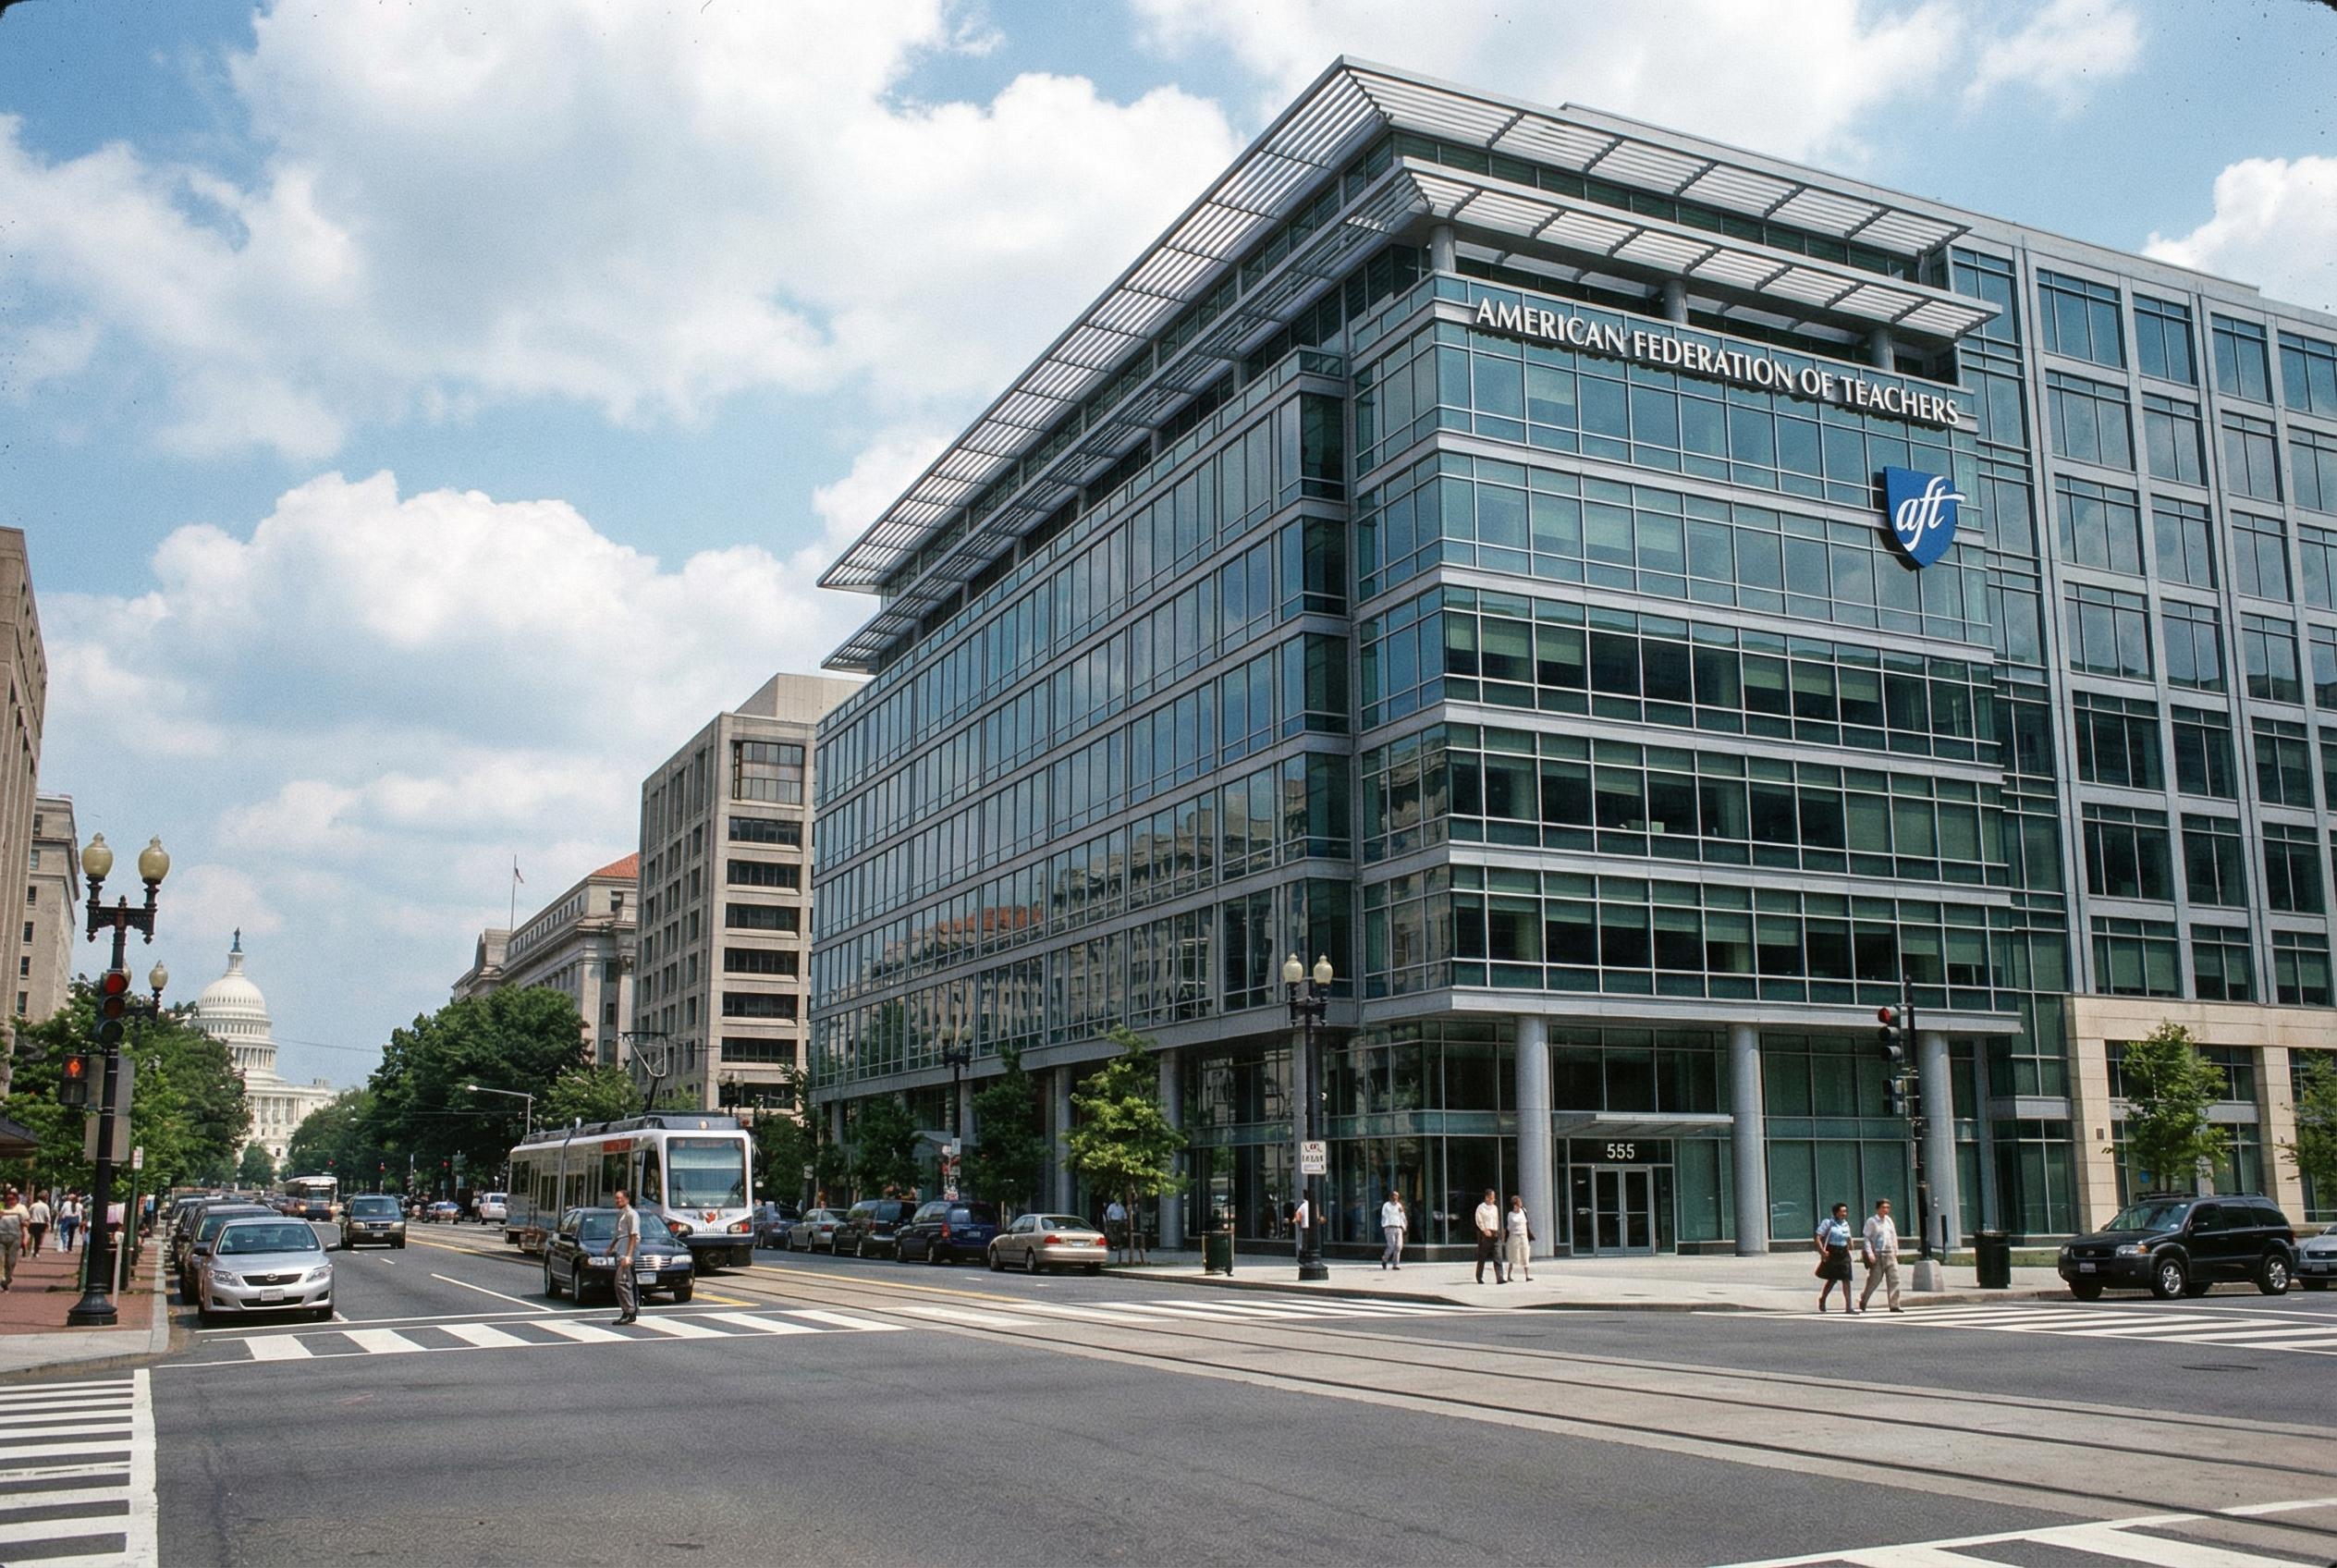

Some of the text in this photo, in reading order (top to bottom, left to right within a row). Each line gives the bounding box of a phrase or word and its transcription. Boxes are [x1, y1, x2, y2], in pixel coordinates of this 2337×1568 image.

[1476, 297, 1959, 425] AMERICAN FEDERATION OF TEACHERS
[1896, 475, 1966, 552] aft
[1607, 1143, 1635, 1159] 555
